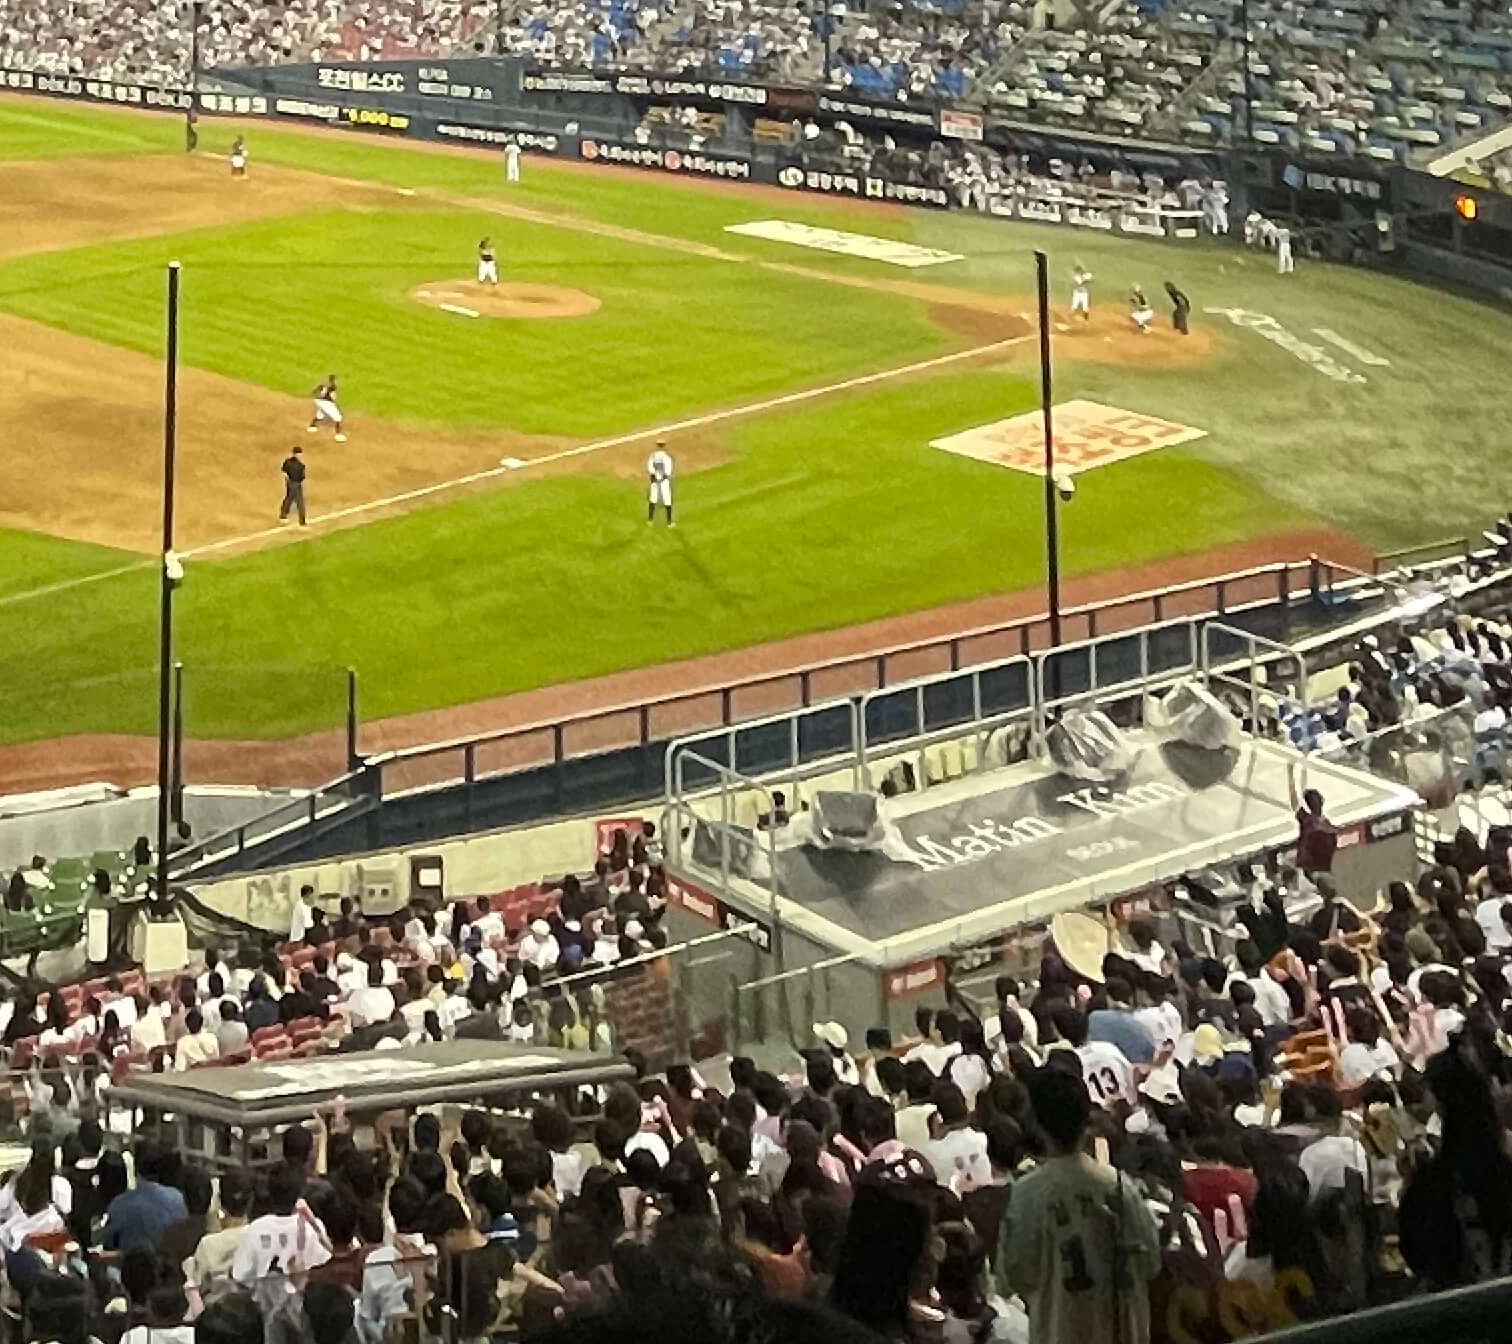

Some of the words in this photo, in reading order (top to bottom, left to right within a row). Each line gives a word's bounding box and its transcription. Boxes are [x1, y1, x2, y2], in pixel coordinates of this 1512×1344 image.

[915, 816, 1065, 872] Matin
[1056, 781, 1187, 818] Kim
[1089, 1066, 1119, 1099] 13
